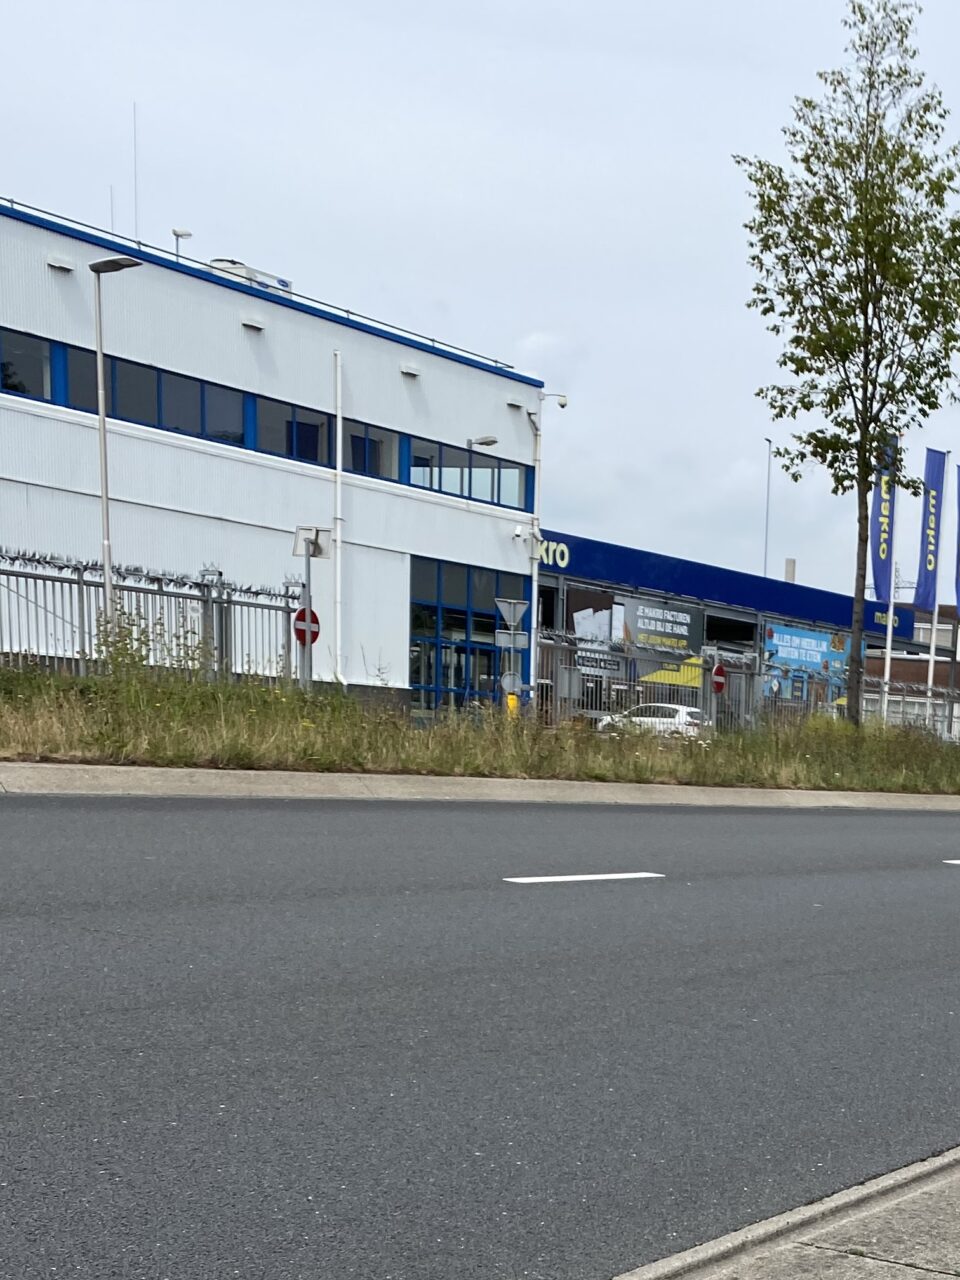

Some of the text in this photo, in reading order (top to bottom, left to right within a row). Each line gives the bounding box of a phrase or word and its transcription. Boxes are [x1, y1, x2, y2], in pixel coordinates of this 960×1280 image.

[539, 540, 569, 568] kro
[879, 475, 890, 560] makro
[926, 490, 937, 571] makro
